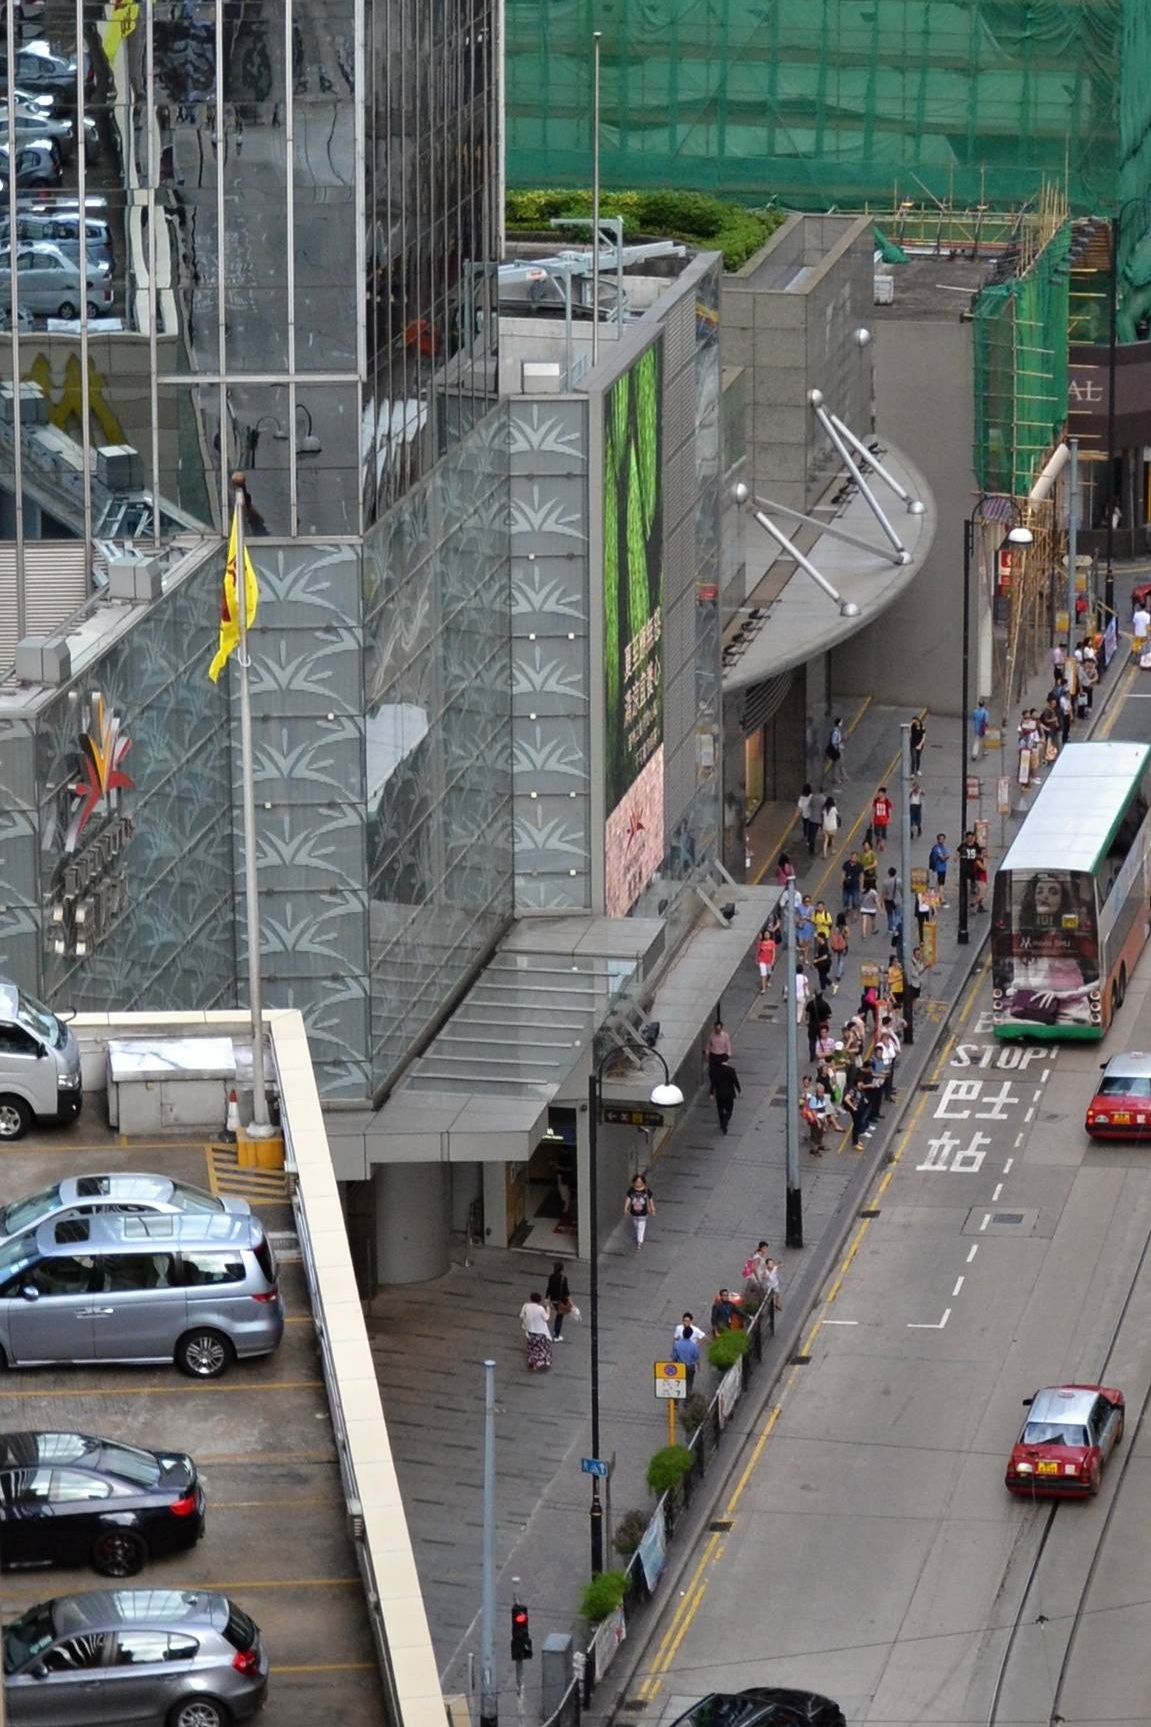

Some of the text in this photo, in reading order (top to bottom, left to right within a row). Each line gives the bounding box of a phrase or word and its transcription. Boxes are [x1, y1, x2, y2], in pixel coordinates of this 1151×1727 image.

[950, 1044, 1049, 1070] STOP
[933, 1079, 1020, 1120] 巴士
[915, 1131, 992, 1173] 站
